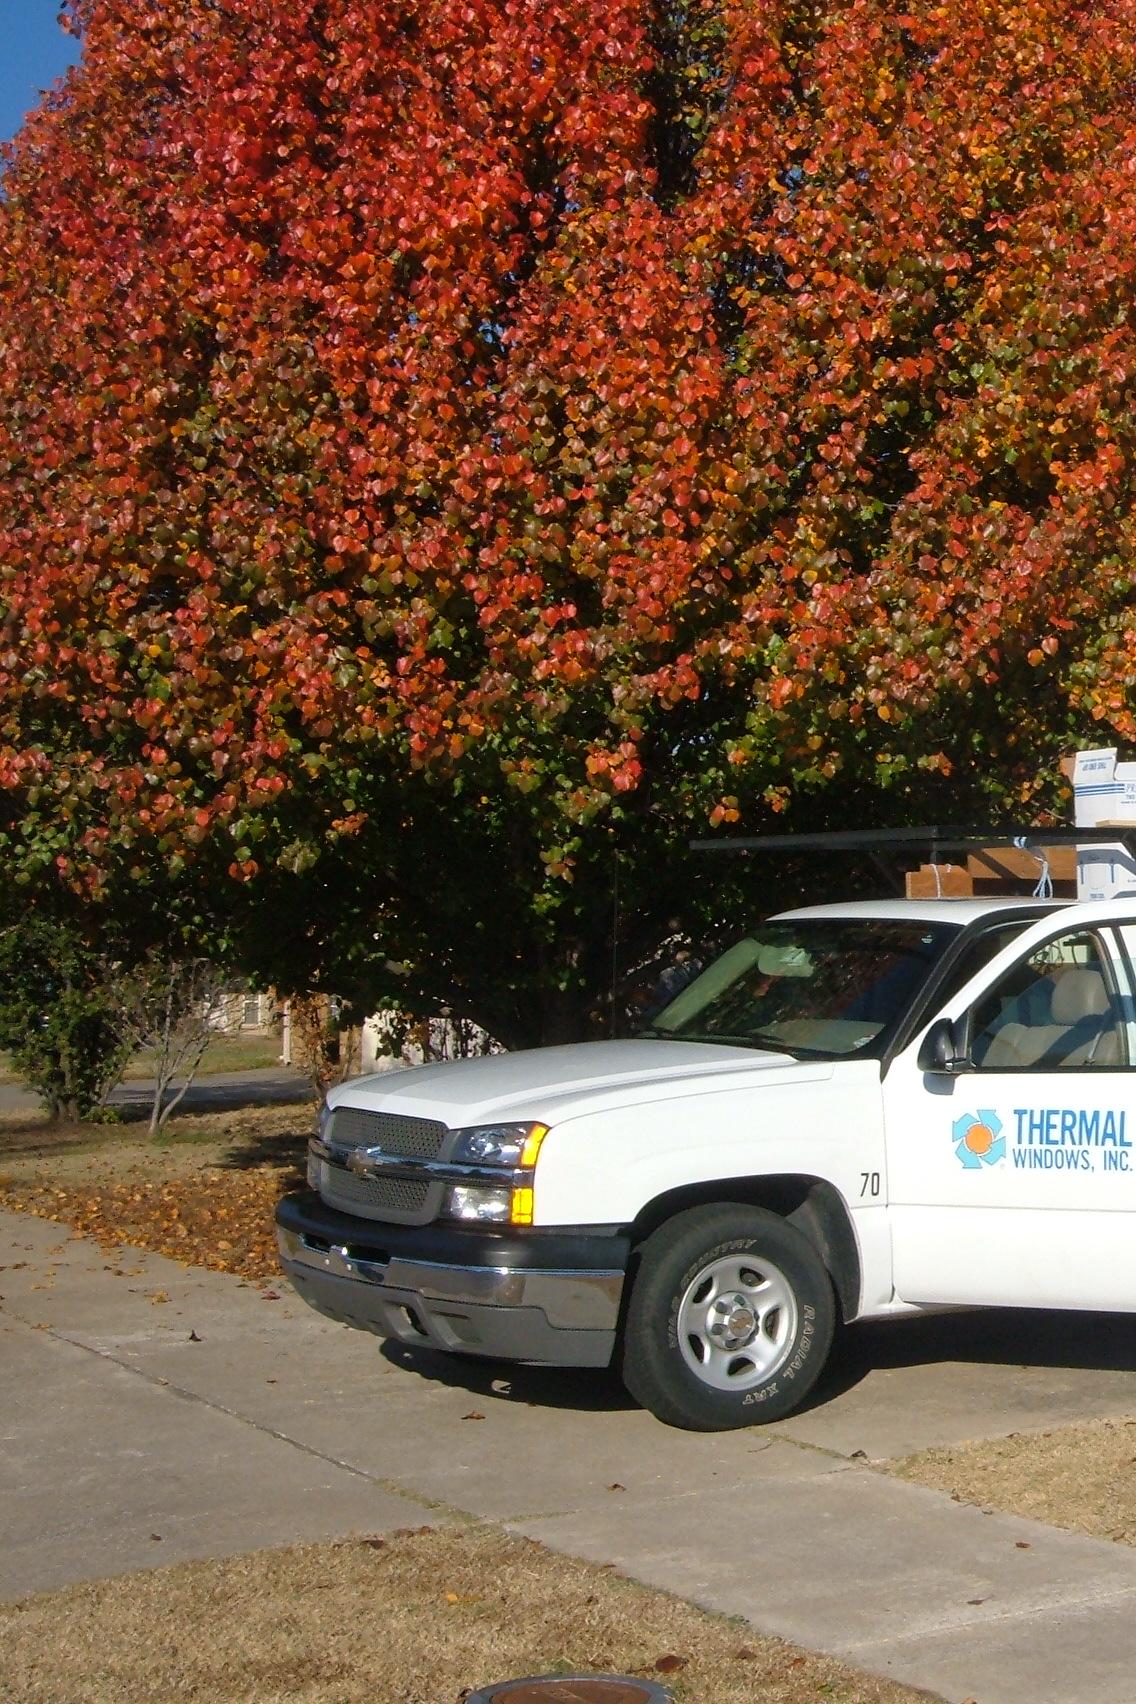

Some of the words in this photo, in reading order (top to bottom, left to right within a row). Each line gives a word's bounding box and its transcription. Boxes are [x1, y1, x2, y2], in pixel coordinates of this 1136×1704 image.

[1013, 1109, 1133, 1147] THERMAL
[1012, 1148, 1095, 1173] WINDOWS,
[1103, 1150, 1134, 1172] INC.
[860, 1172, 880, 1197] 70
[782, 1304, 816, 1379] RADIAL
